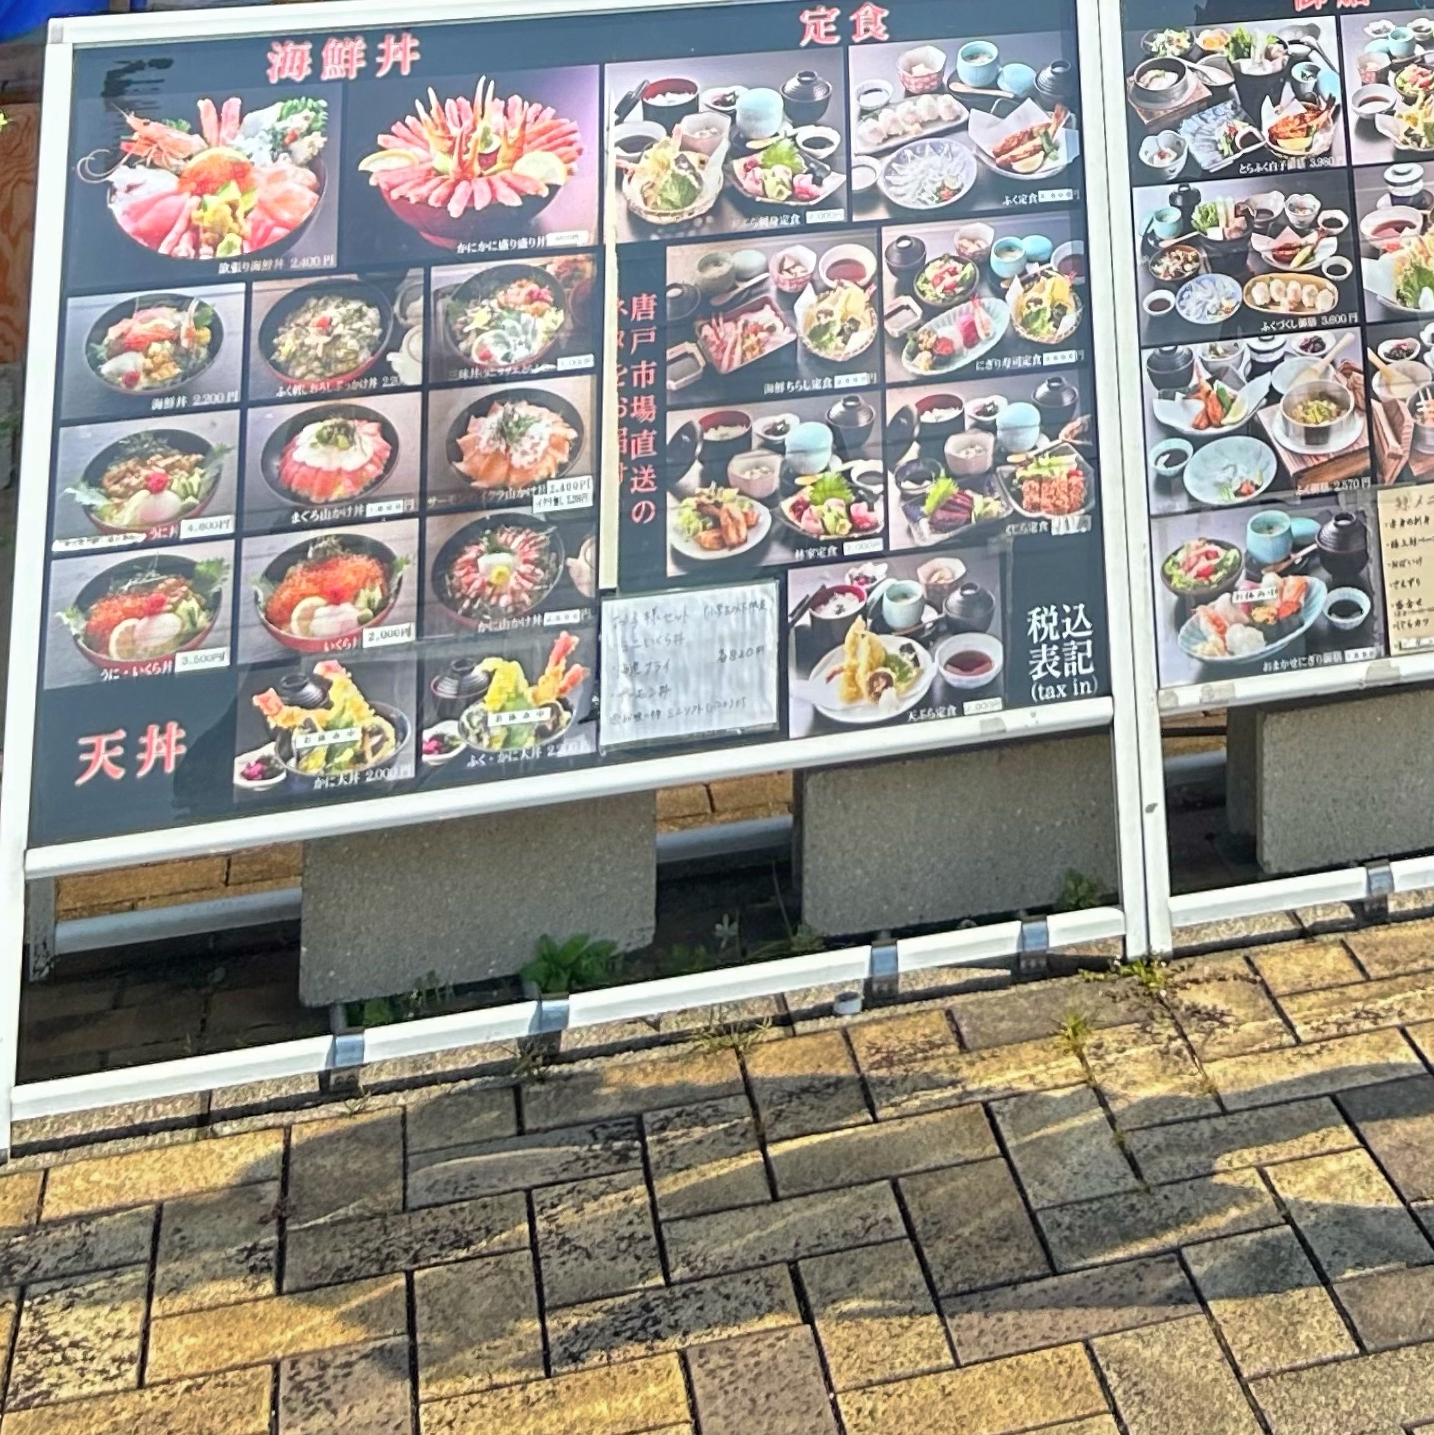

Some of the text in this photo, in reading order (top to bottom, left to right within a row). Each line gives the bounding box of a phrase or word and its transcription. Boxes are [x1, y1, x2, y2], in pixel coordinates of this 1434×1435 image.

[799, 0, 890, 48] 定食
[265, 31, 421, 85] 海鮮丼
[630, 292, 658, 525] 唐戸市場直送の
[1027, 604, 1094, 644] 税込
[1029, 640, 1096, 681] 表記
[1031, 675, 1098, 703] (tax in)
[74, 720, 187, 787] 天丼
